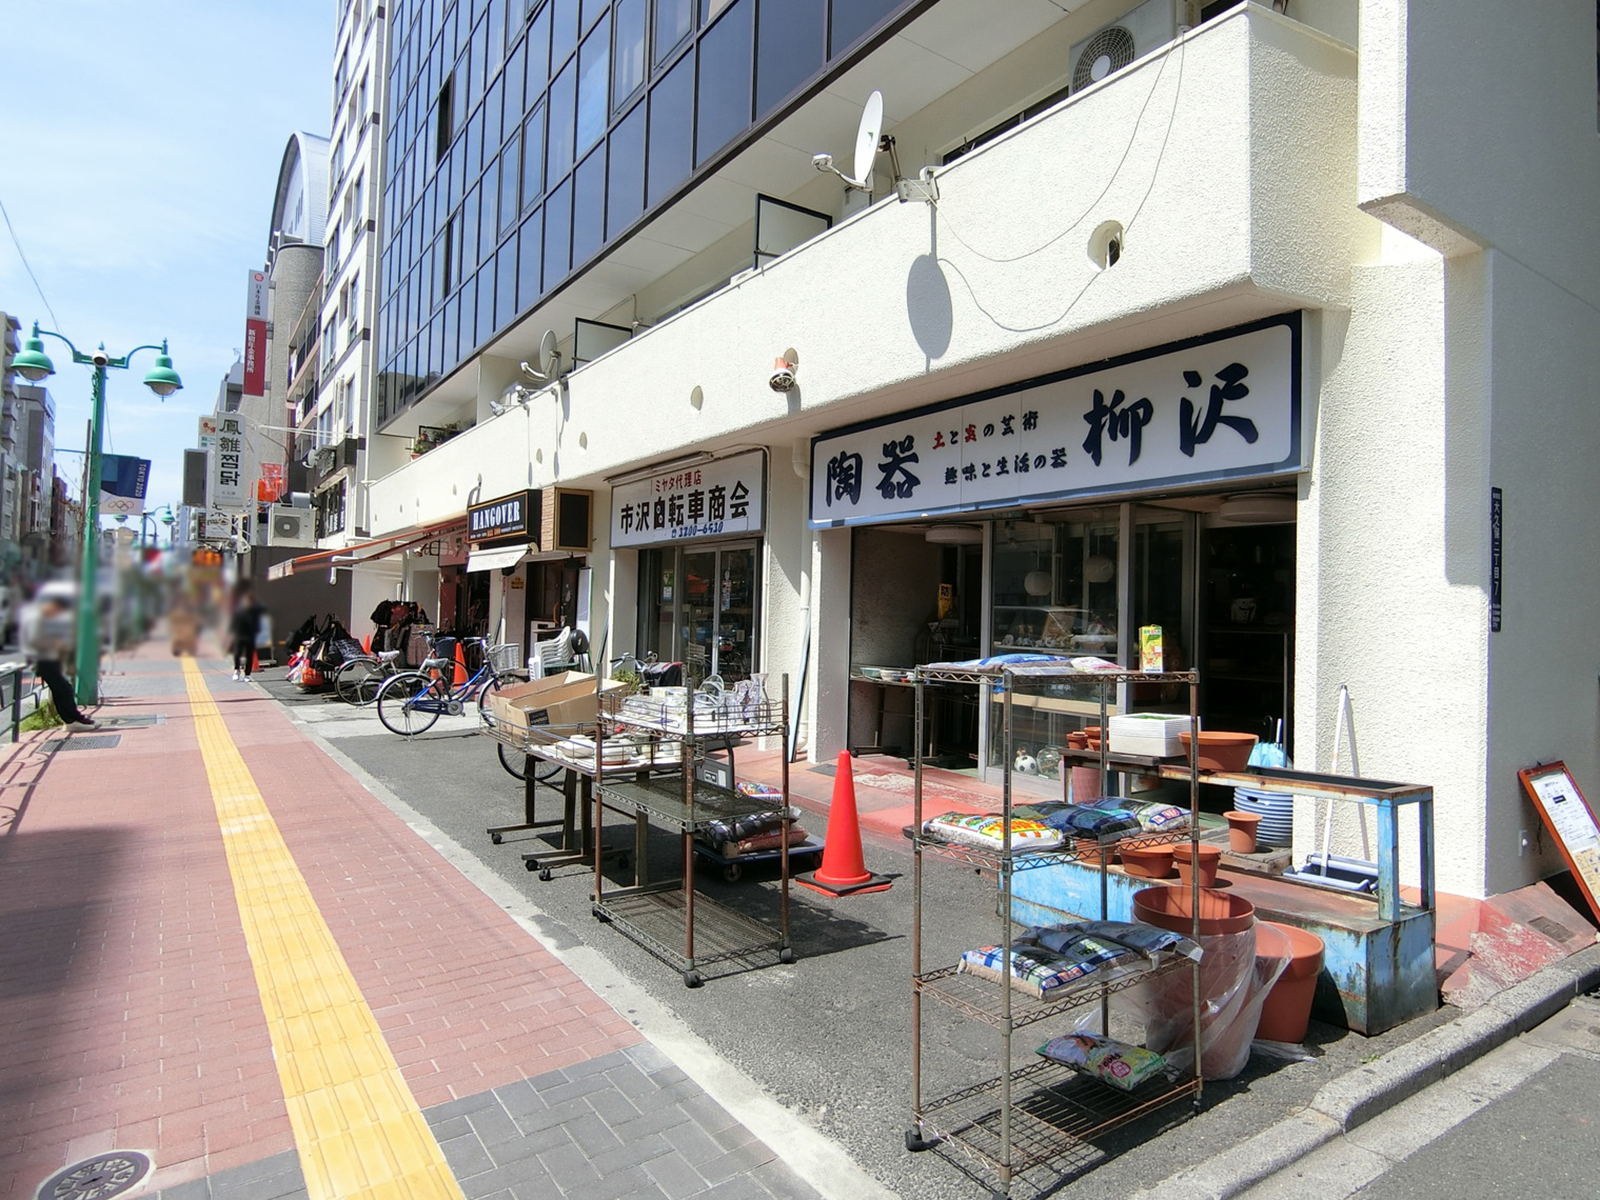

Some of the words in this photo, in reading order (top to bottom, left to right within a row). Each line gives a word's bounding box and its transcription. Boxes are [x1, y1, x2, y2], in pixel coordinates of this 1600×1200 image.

[1082, 362, 1259, 467] 柳沢
[137, 463, 147, 482] TOKYO
[655, 469, 702, 493] ミヤタ代理店
[825, 434, 921, 508] 陶器
[944, 447, 1068, 485] 趣味と生活の器
[135, 482, 144, 497] 2020
[473, 500, 521, 531] HANGOVER
[620, 480, 750, 535] 市沢自転車商会
